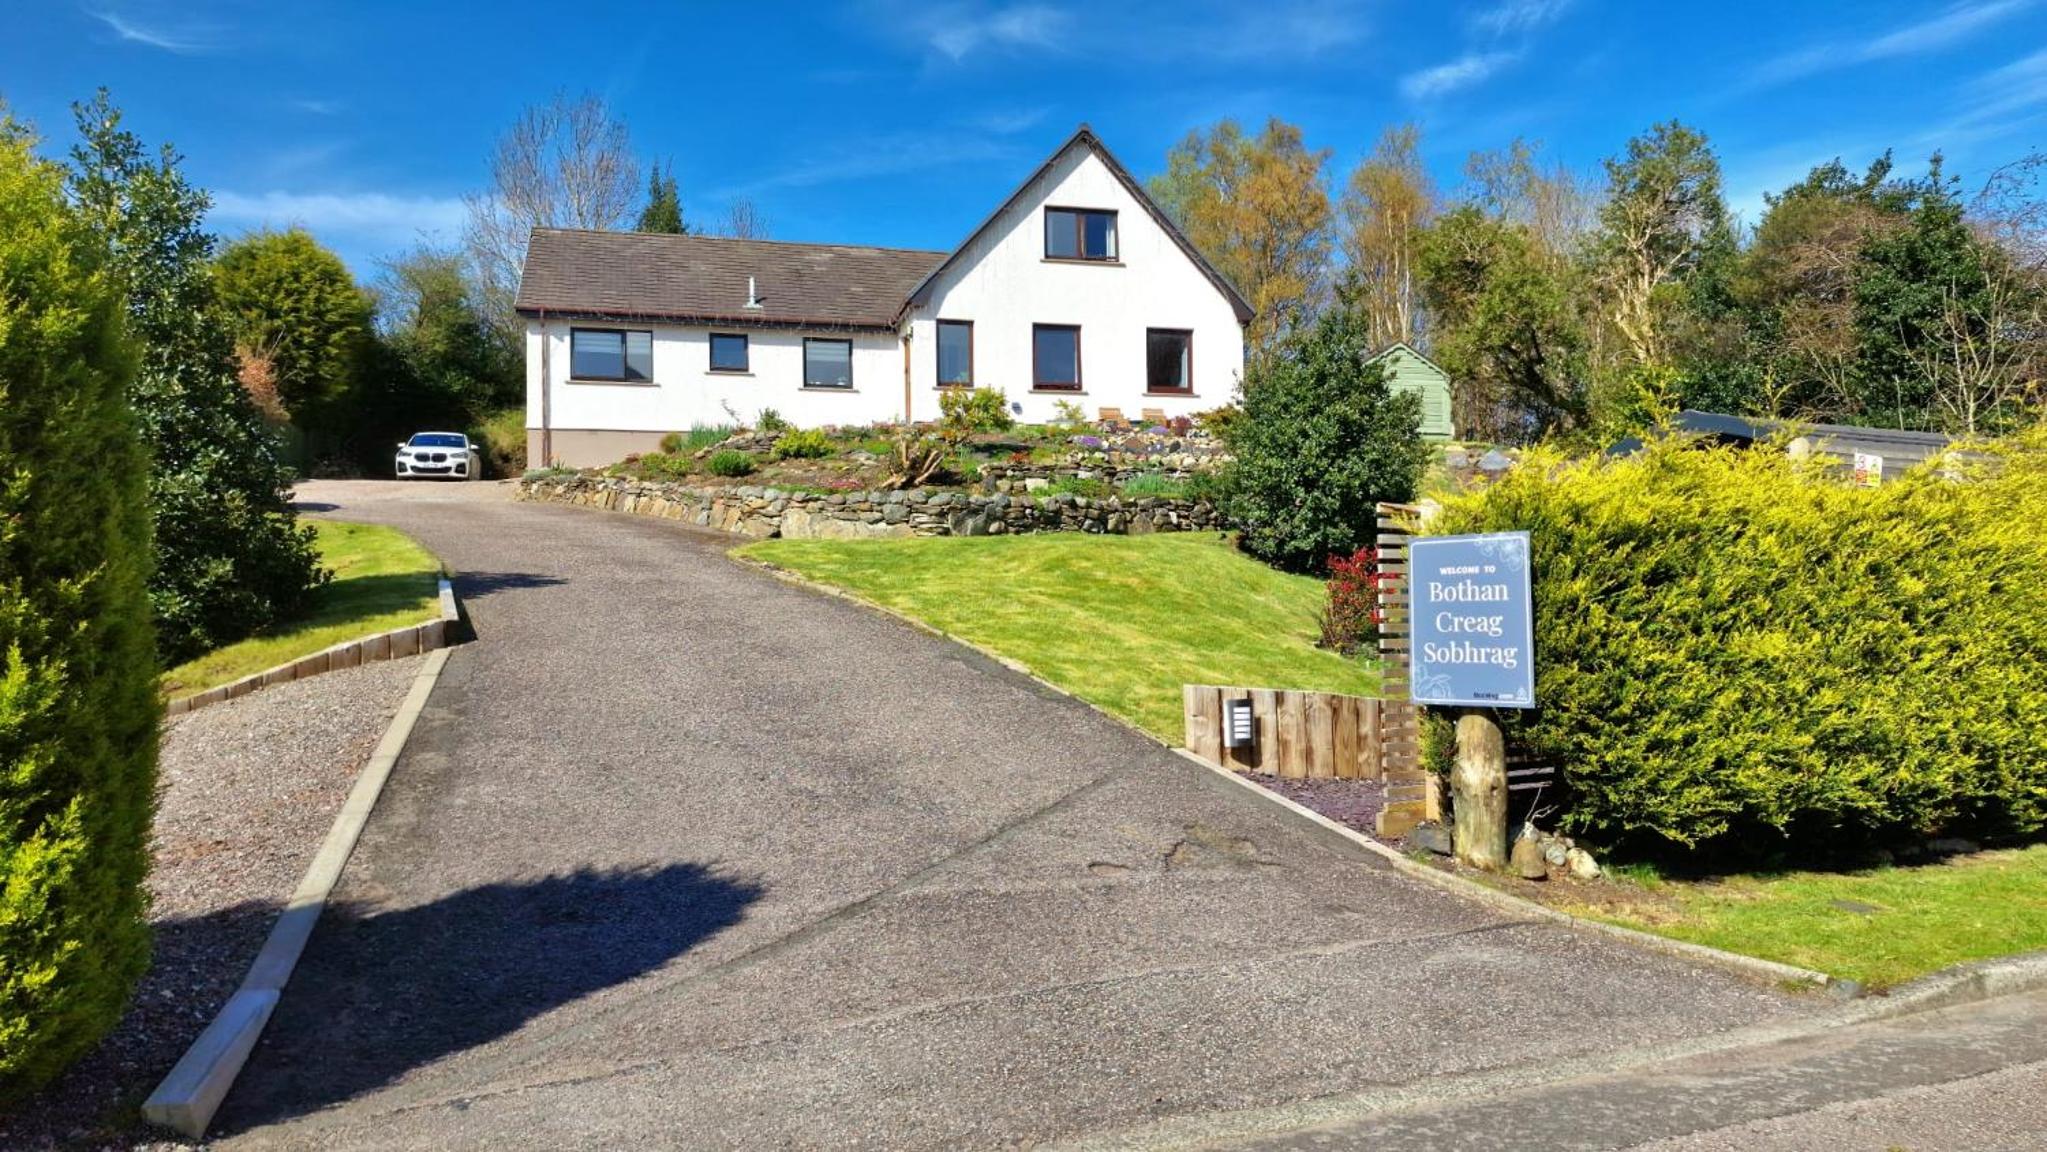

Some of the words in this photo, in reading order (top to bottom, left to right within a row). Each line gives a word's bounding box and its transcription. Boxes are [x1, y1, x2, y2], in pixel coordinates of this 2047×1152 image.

[1439, 565, 1480, 575] WELCOME
[1484, 564, 1496, 574] TO
[1429, 579, 1509, 602] Bothan
[1436, 611, 1503, 637] Creag
[1423, 641, 1518, 669] Sobhrag
